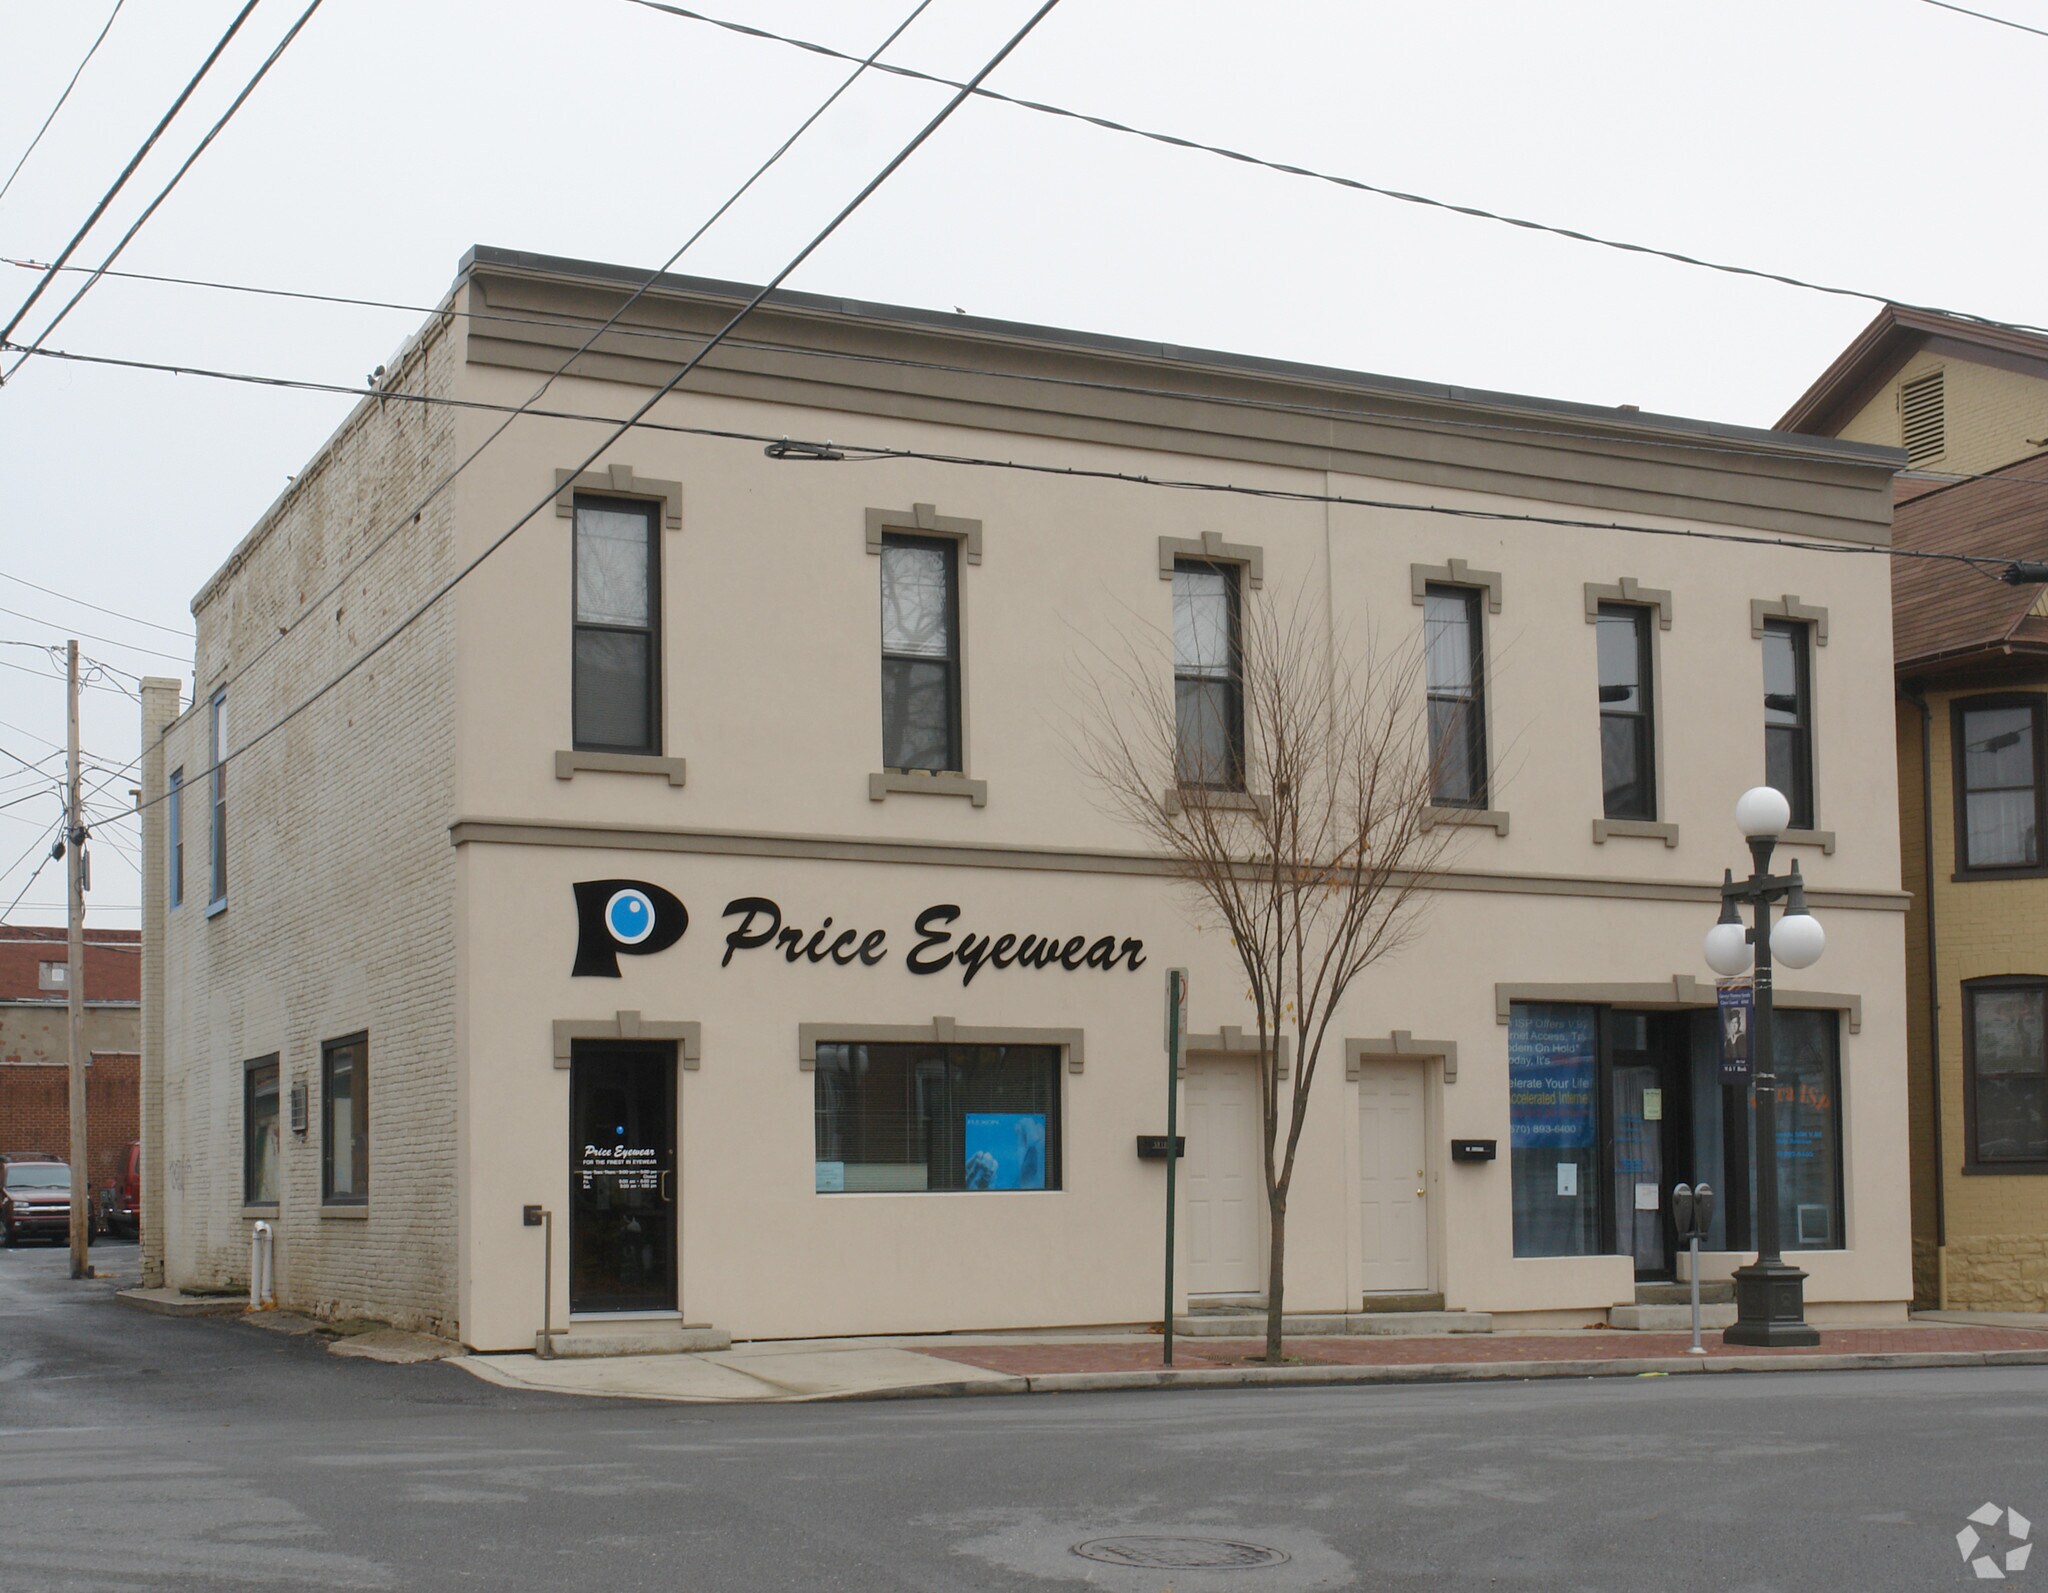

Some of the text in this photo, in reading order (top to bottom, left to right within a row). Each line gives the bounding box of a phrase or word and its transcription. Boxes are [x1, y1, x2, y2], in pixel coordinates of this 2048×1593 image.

[722, 897, 1146, 987] Price Eyewear
[1535, 1043, 1550, 1053] On
[1545, 1077, 1569, 1089] Your
[1509, 1091, 1591, 1105] ccelerated Interne
[1531, 1124, 1577, 1134] 893-6400
[584, 1144, 656, 1160] Price Eyewear
